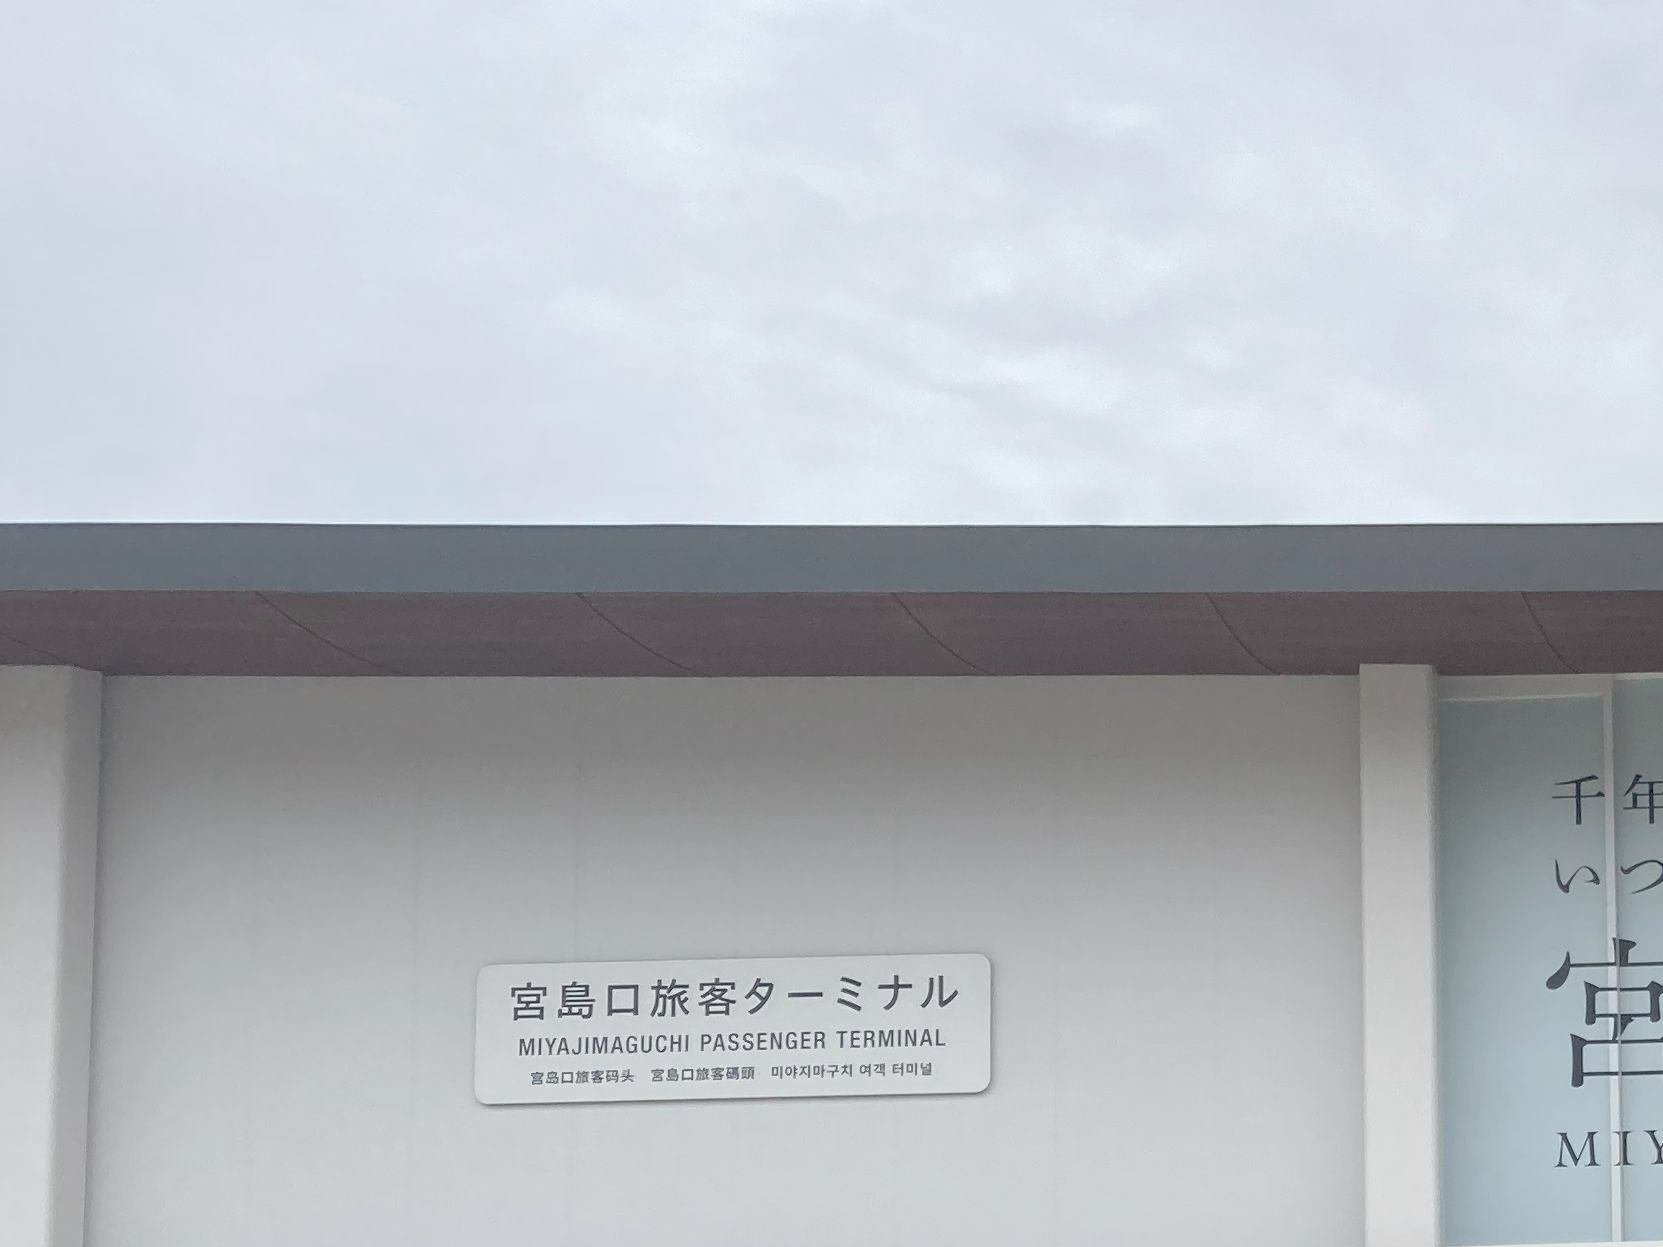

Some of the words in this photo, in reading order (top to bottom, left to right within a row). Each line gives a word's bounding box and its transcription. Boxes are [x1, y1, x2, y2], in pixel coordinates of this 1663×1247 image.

[510, 974, 960, 1021] 宮島口旅客ターミナル
[518, 1034, 690, 1057] MIYAJIMAGUCHI
[700, 1031, 826, 1054] PASSENGER
[836, 1028, 947, 1050] TERMINAL
[770, 1064, 853, 1079] 미야지마구치
[860, 1063, 886, 1077] 여객
[892, 1061, 933, 1077] 터미널
